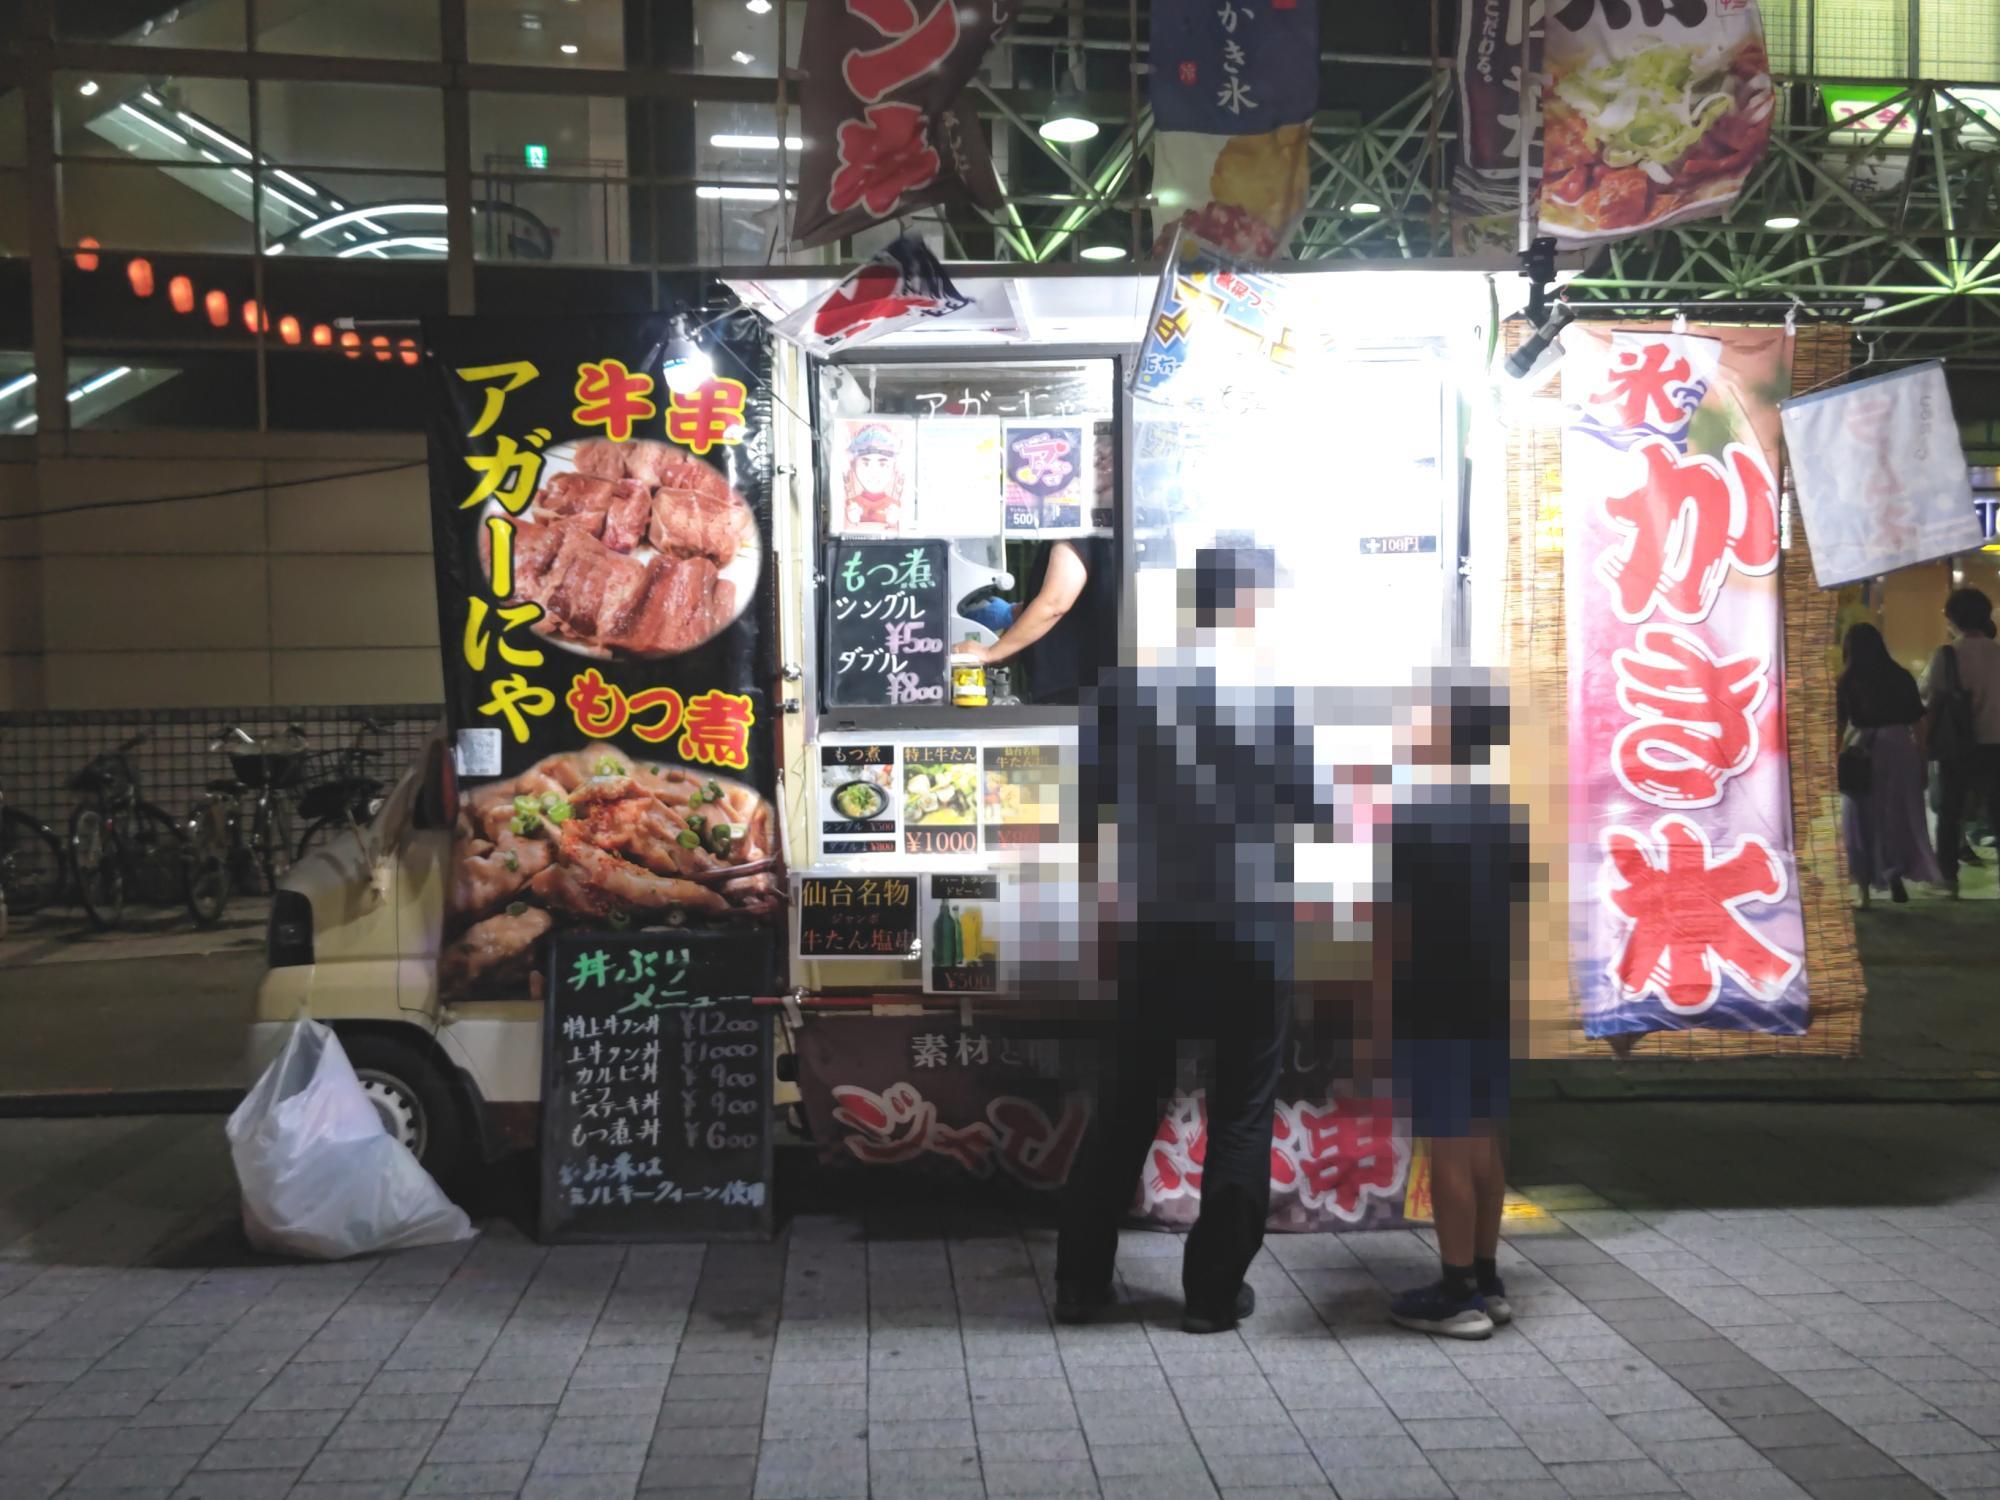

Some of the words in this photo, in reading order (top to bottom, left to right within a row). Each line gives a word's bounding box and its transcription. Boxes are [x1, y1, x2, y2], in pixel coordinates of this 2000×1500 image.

[1216, 1, 1259, 116] かき氷
[572, 359, 747, 454] 牛串
[1591, 342, 1694, 429] 氷
[842, 548, 936, 591] もつ煮
[837, 647, 908, 673] ダブル
[566, 668, 754, 769] もつ煮
[1594, 434, 1802, 1016] かき氷
[834, 746, 882, 763] もつ煮
[903, 746, 976, 762] 特上牛たん
[905, 832, 977, 852] ¥1000
[801, 879, 911, 907] 仙台名物
